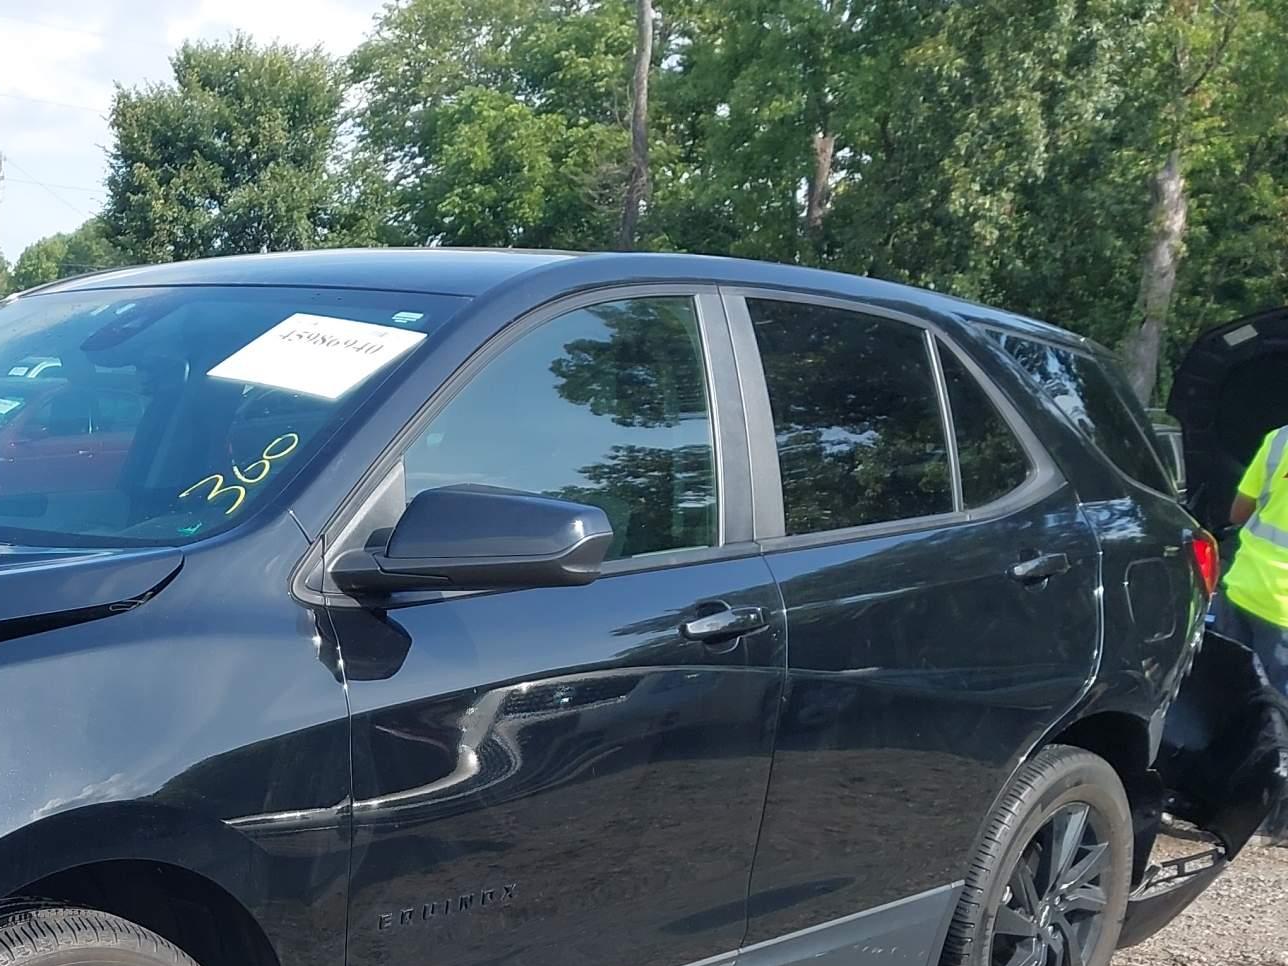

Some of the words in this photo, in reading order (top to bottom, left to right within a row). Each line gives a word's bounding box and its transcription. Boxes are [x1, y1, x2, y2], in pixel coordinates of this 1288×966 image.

[279, 329, 386, 355] 45986940
[178, 432, 299, 516] 360
[377, 881, 518, 931] EQUINOX
